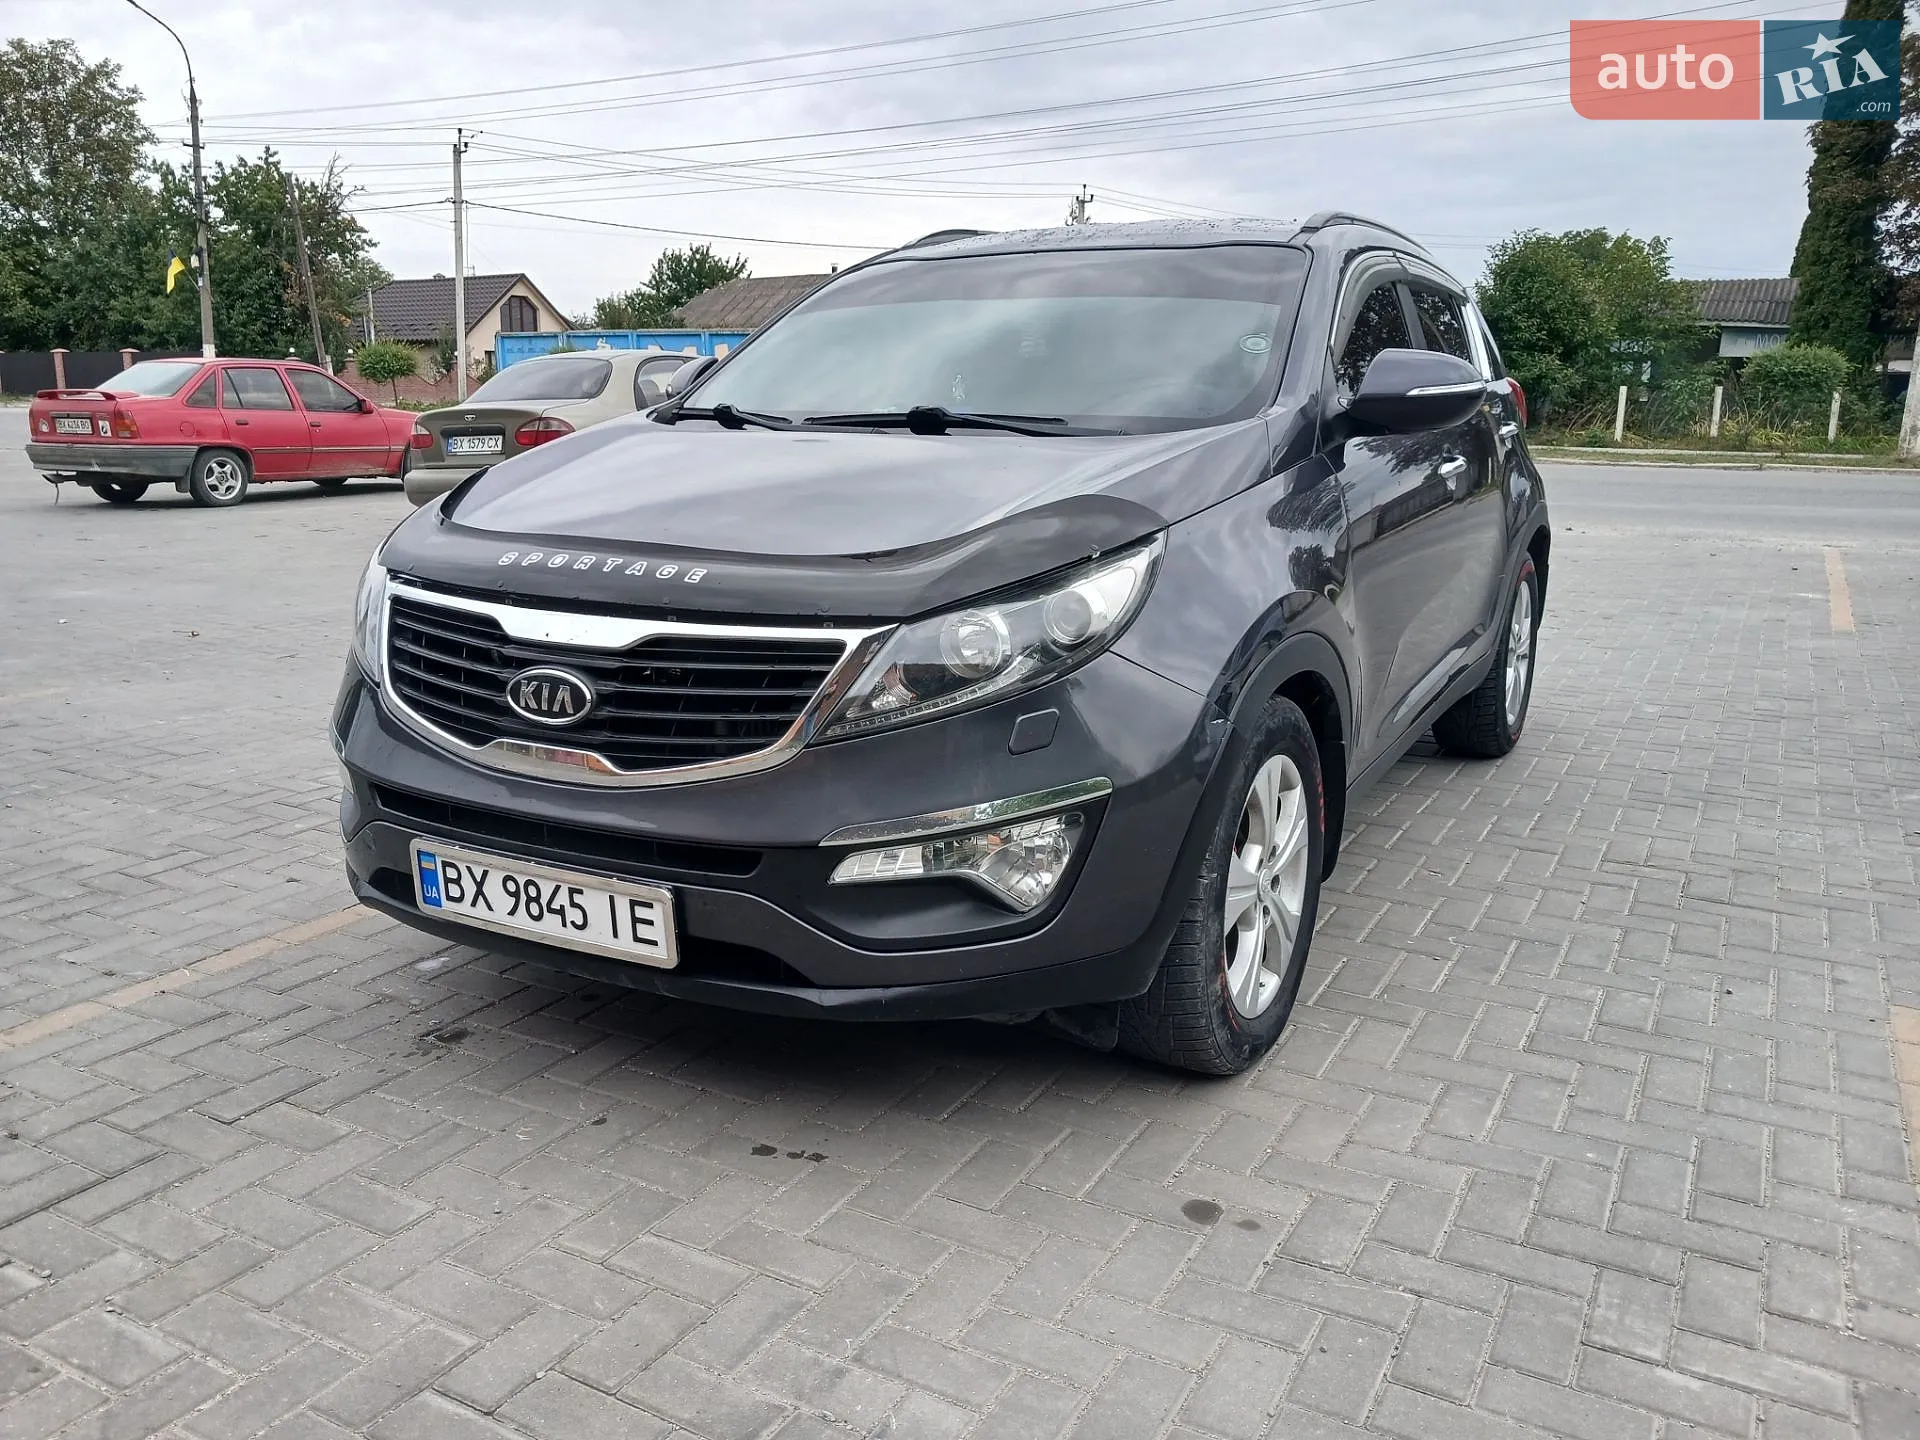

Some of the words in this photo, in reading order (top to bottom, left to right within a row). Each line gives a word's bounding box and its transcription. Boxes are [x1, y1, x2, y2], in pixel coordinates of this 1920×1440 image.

[452, 438, 465, 450] BX
[467, 437, 485, 449] 1579
[486, 436, 500, 449] CX
[498, 552, 708, 583] SPORTAGE
[519, 680, 574, 714] KIA
[423, 884, 440, 900] UA
[440, 860, 494, 912] BX
[502, 874, 588, 931] 9845
[608, 894, 659, 947] IE
